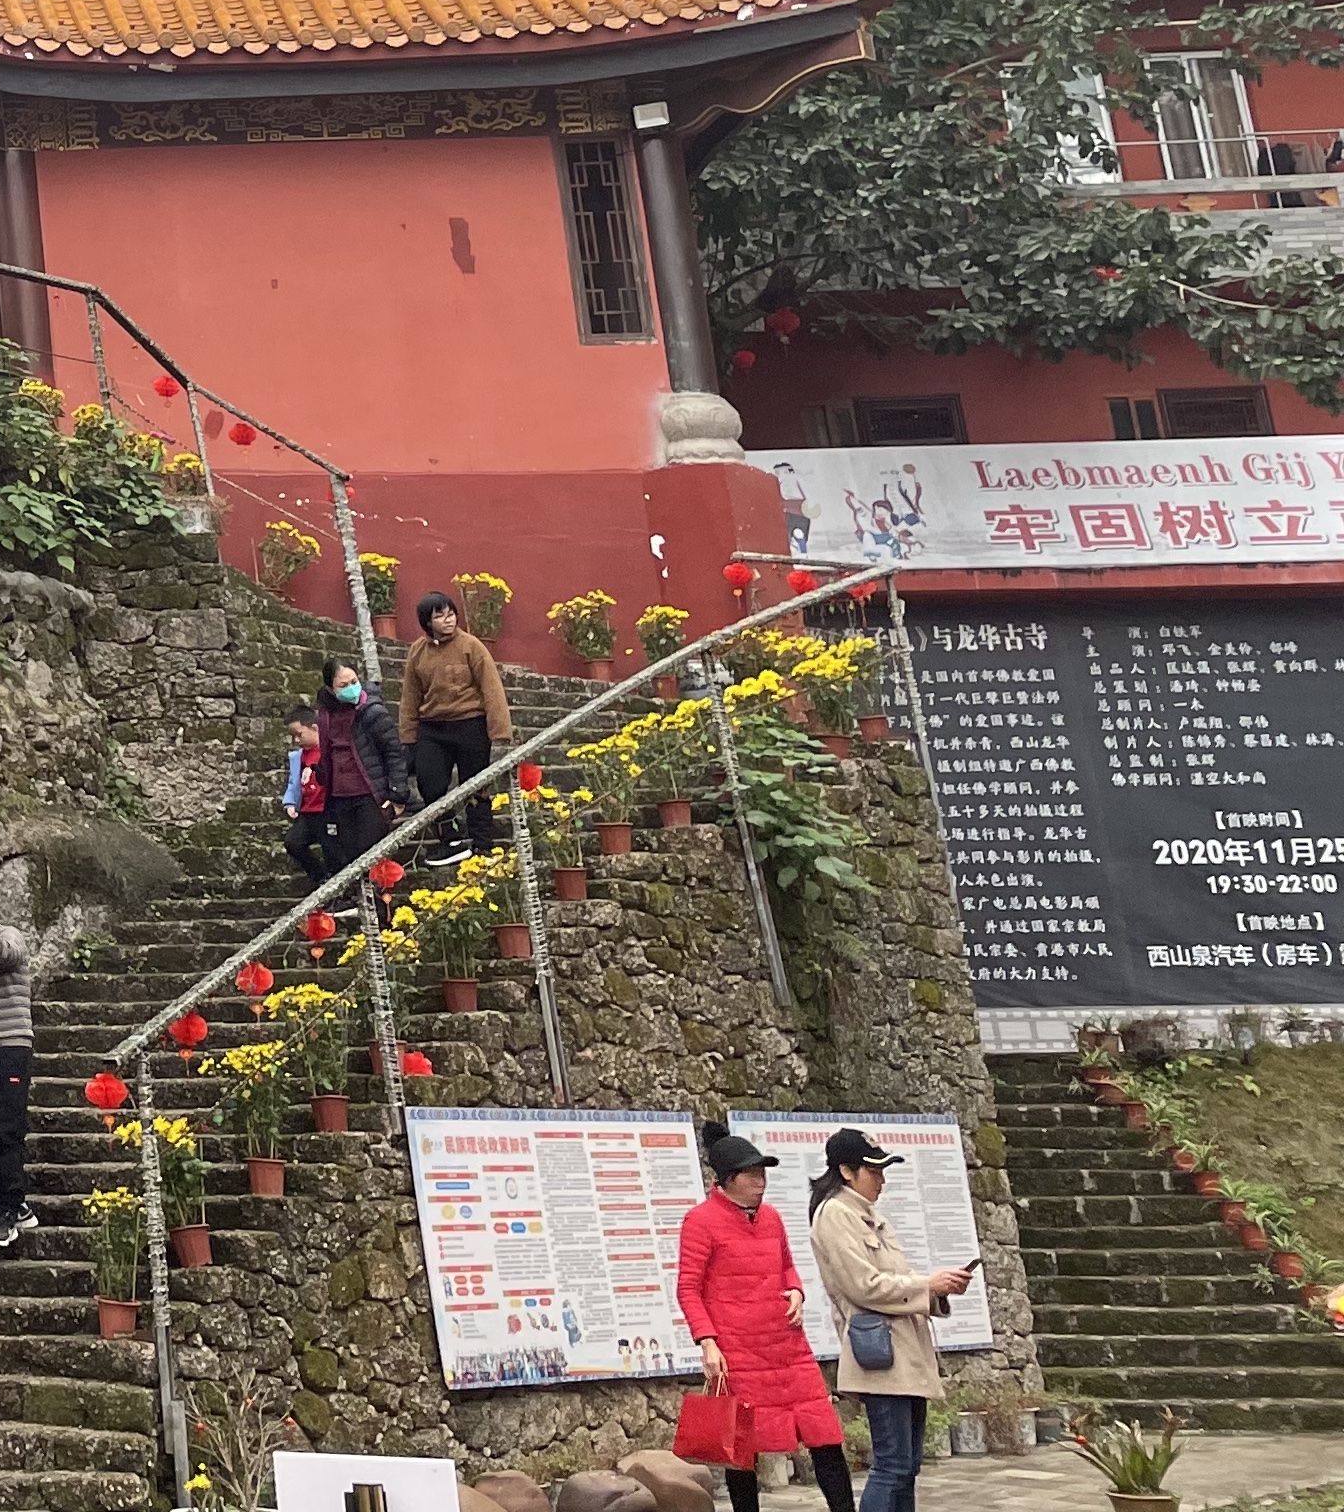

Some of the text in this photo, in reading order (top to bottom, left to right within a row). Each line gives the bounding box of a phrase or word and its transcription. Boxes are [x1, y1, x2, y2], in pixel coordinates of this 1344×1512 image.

[970, 454, 1235, 490] Laebmaenh
[1242, 452, 1315, 491] Gij
[1146, 942, 1344, 969] 西山泉汽车（房车）
